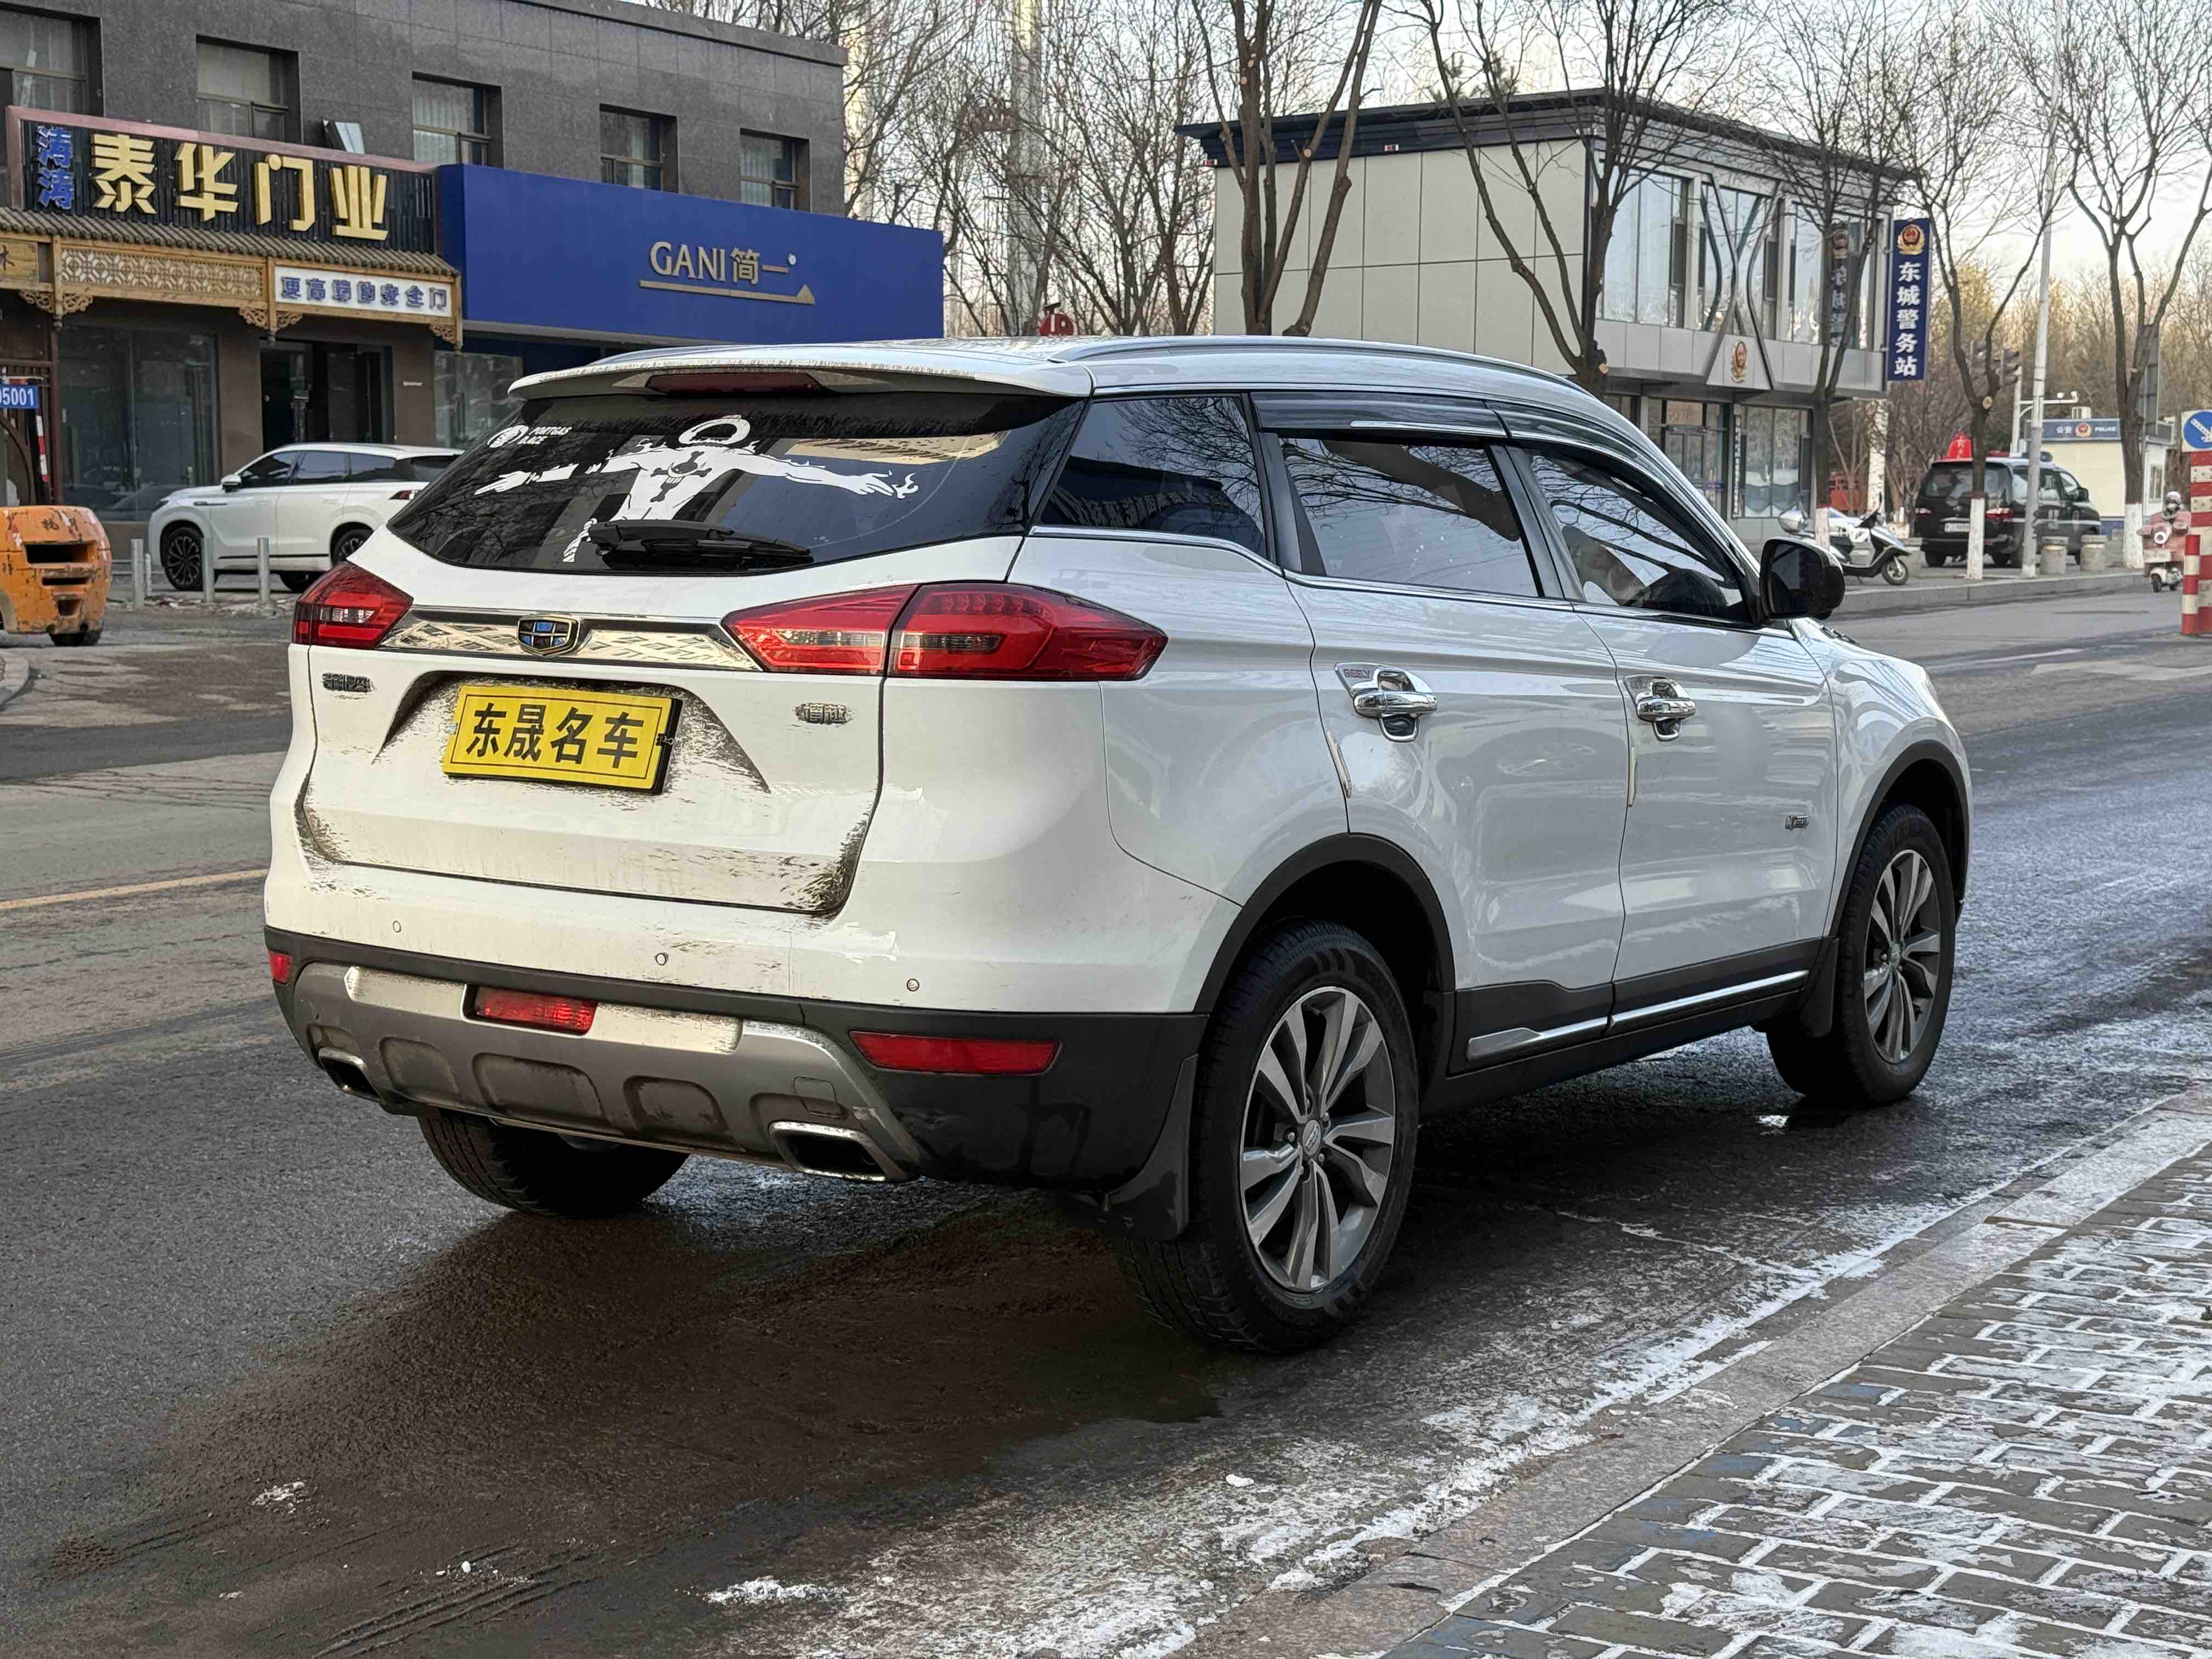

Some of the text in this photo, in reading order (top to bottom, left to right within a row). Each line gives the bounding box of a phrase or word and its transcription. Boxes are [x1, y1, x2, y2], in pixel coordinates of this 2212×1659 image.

[91, 133, 388, 241] 泰华门业
[280, 276, 448, 310] 更高端的安全门
[650, 241, 790, 285] GANI 简一
[1894, 261, 1922, 377] 东城警务站
[465, 702, 645, 769] 东晟名车
